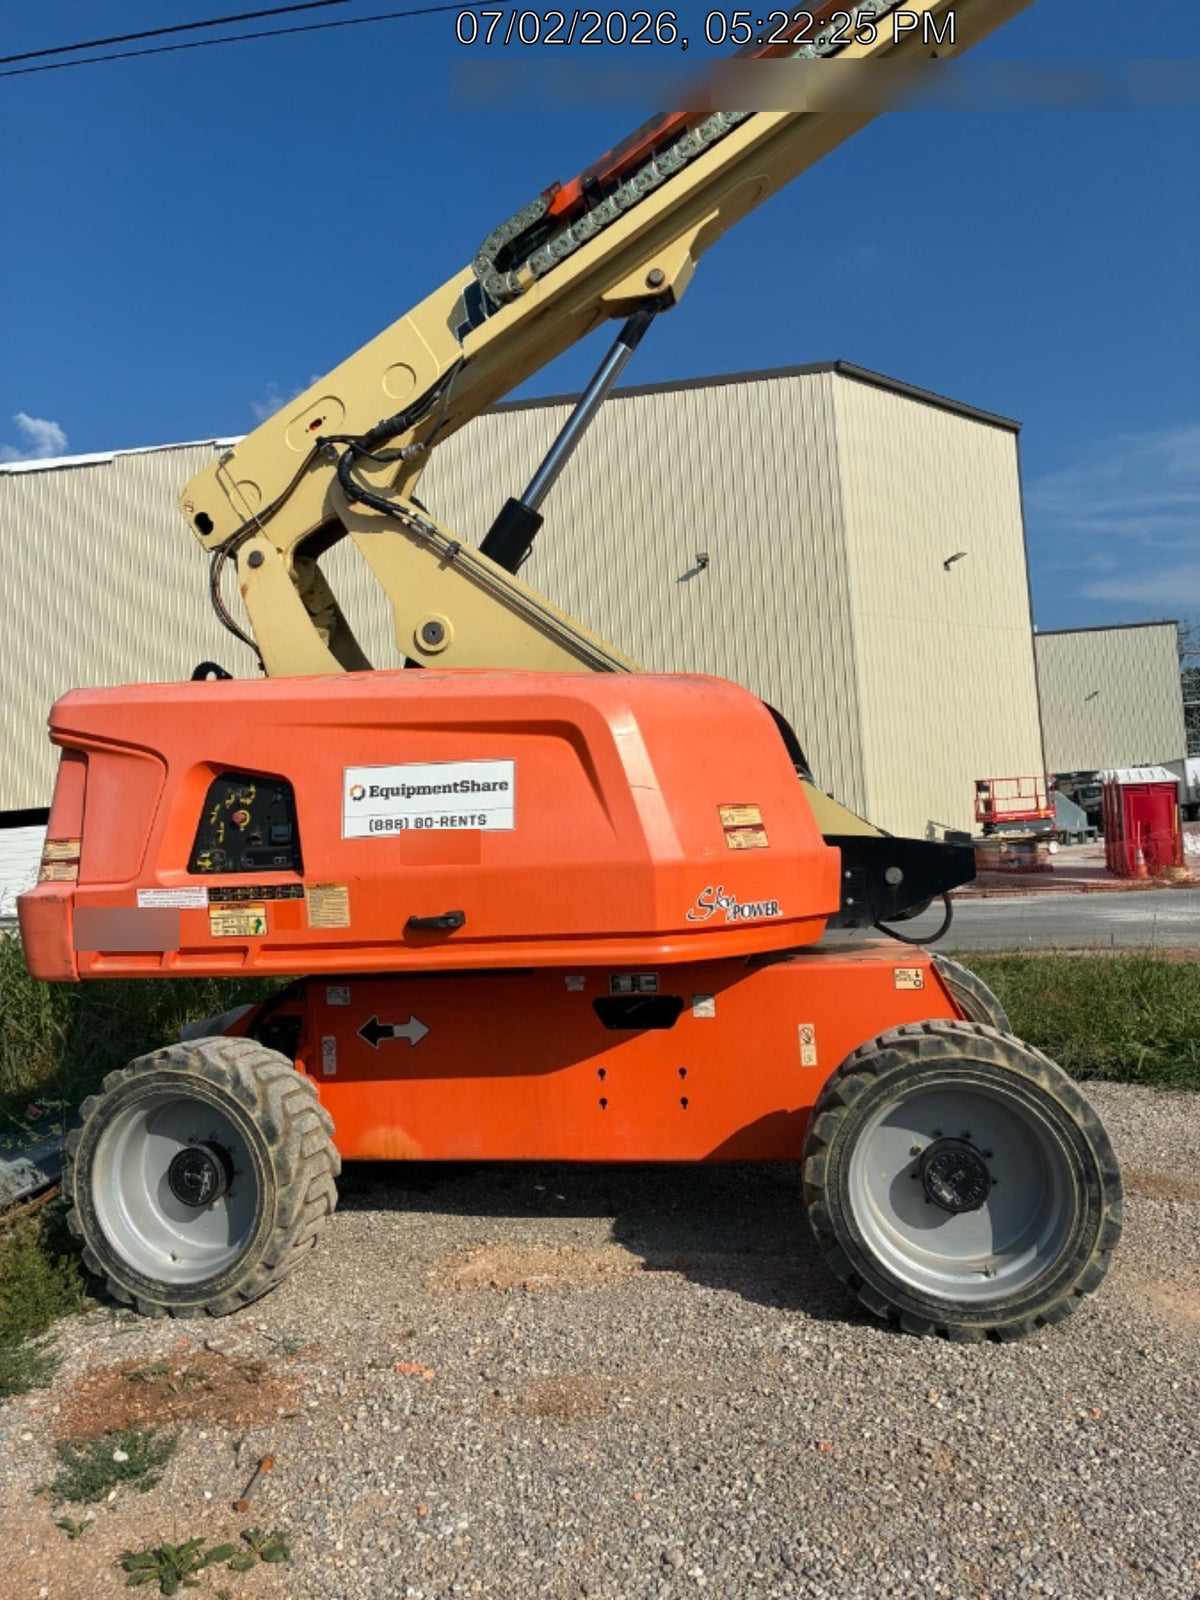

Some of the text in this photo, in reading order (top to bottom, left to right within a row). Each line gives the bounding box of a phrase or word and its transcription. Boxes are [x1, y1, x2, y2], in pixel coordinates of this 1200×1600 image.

[368, 779, 509, 801] EquipmentShare
[368, 813, 487, 832] (888) 80-RENTS
